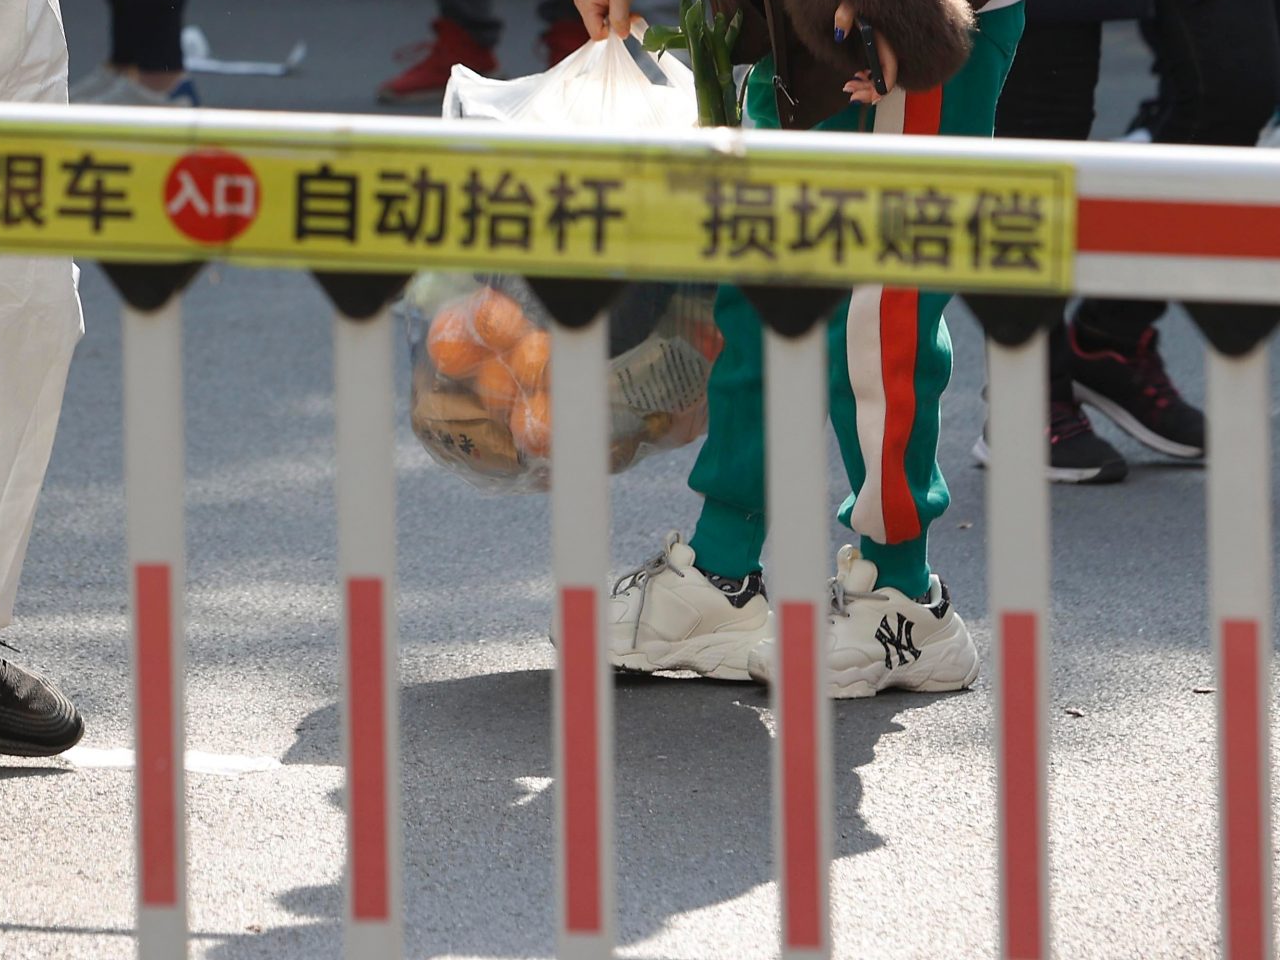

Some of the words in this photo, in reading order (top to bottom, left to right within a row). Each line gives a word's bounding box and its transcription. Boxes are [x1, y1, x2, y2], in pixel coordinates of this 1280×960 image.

[166, 171, 256, 218] 入口
[294, 165, 625, 254] 自动抬杆
[701, 176, 1044, 273] 损坏赔偿
[875, 612, 922, 671] NY
